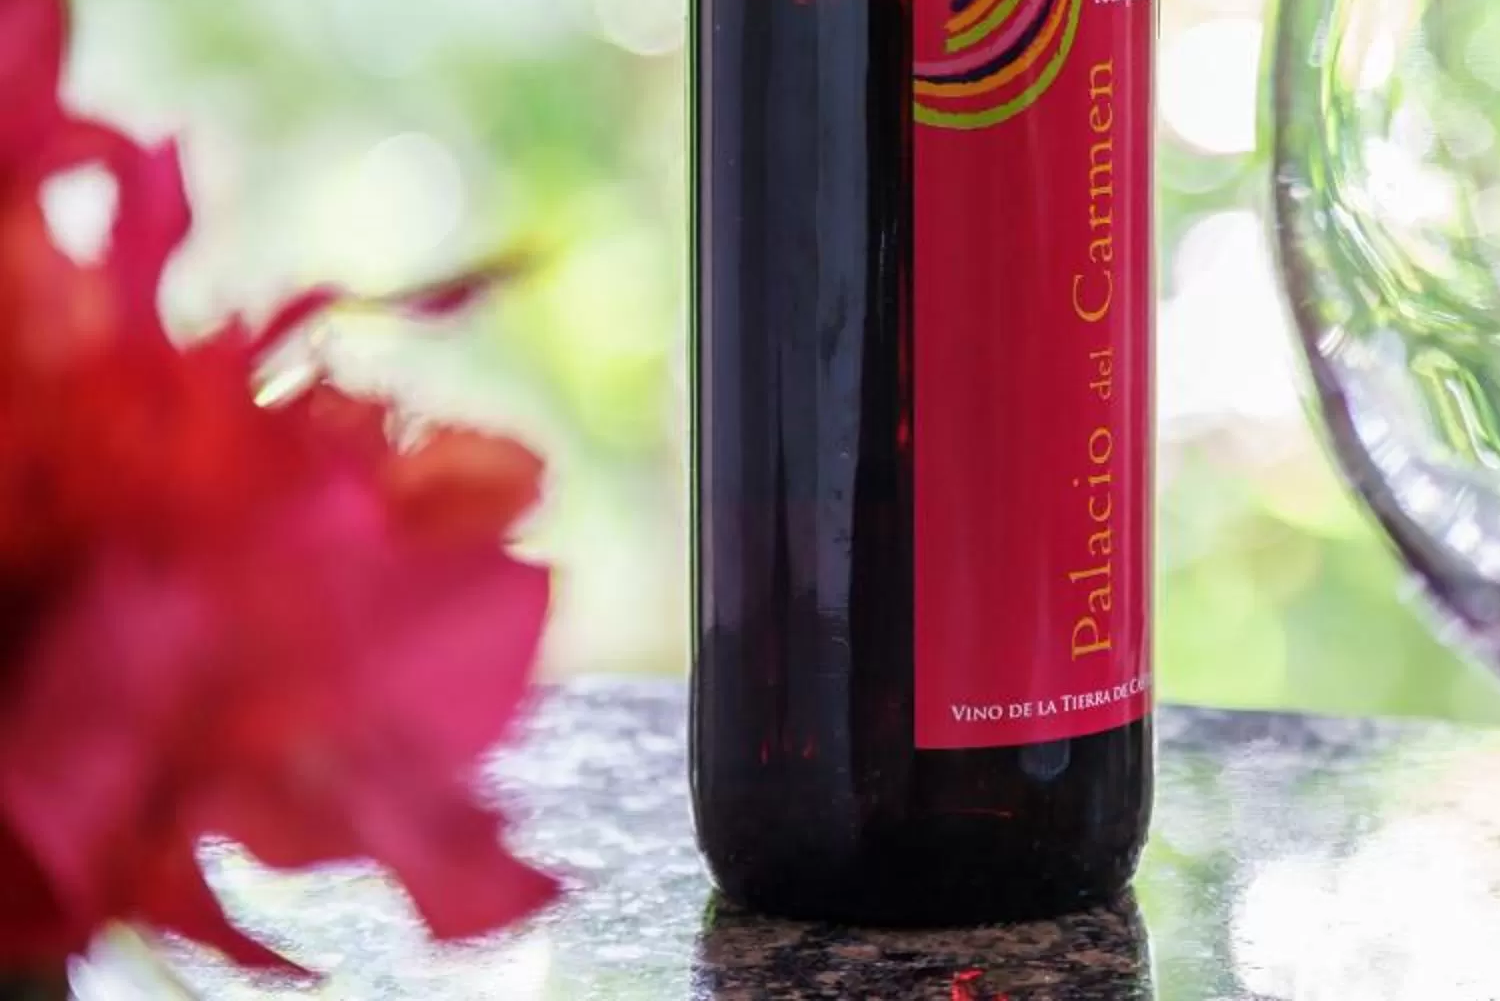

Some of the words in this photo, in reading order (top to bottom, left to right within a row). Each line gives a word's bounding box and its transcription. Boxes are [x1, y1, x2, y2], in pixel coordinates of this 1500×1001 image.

[1072, 59, 1114, 322] Carmen
[1088, 346, 1114, 400] del
[1069, 427, 1113, 662] Palacio
[951, 705, 1003, 722] VINO
[1009, 703, 1032, 719] DE
[1038, 701, 1057, 716] LA
[1060, 691, 1111, 712] TIERRA
